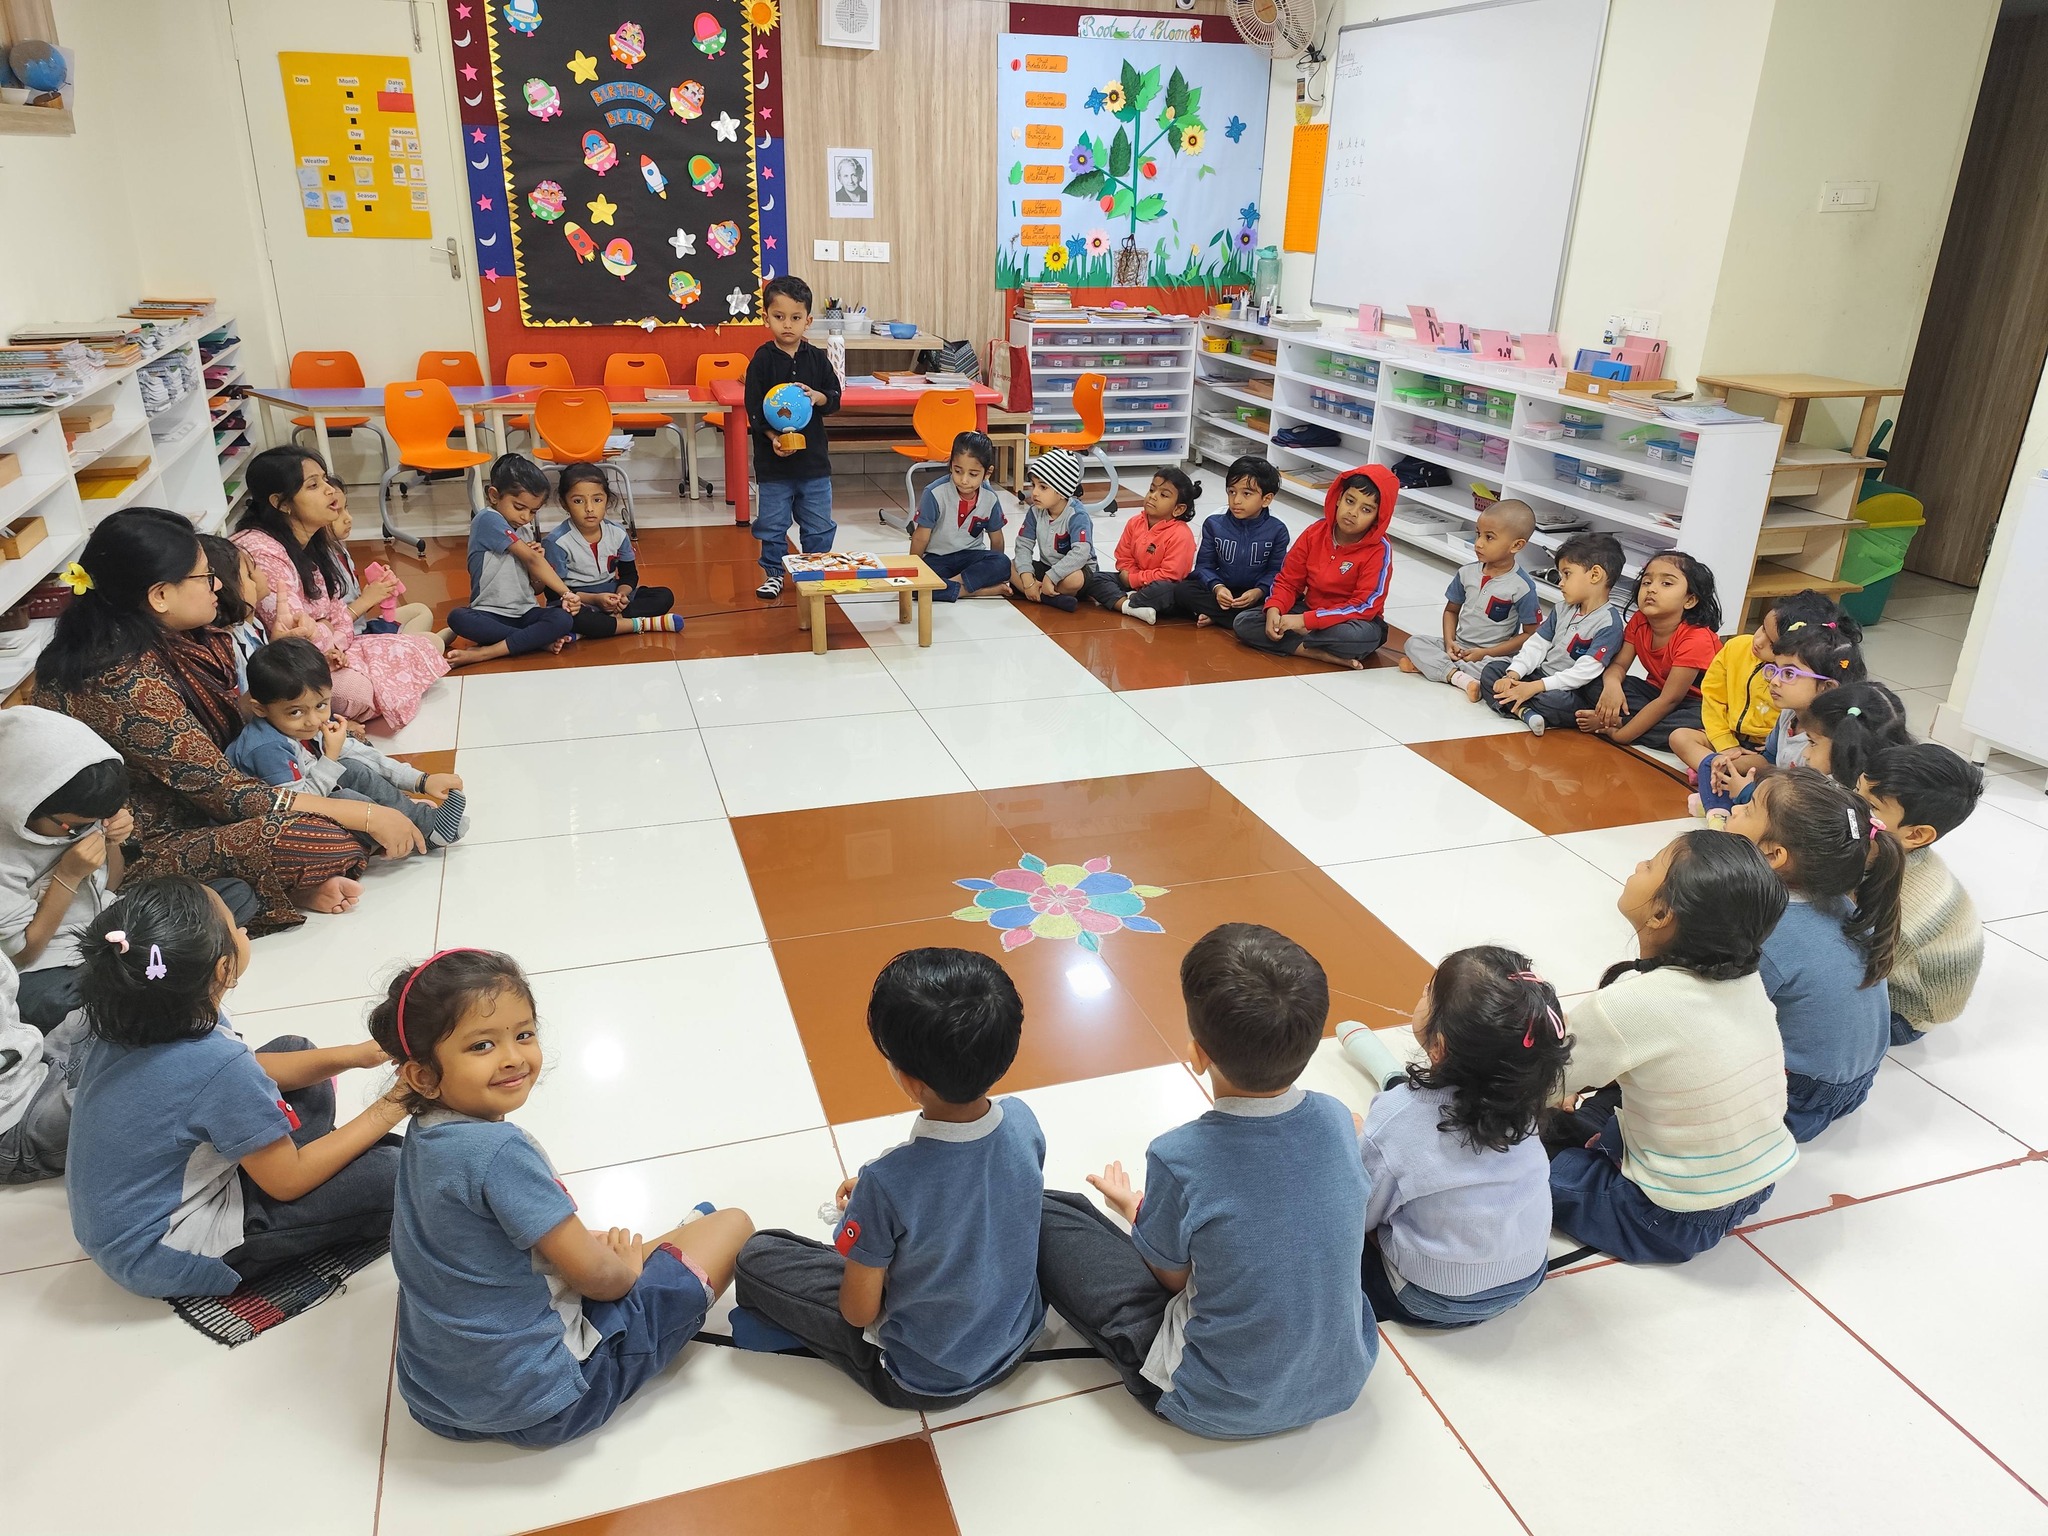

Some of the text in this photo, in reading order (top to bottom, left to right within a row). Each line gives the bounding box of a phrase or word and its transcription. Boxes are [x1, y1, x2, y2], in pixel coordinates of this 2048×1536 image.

[1083, 16, 1123, 38] Root
[1131, 19, 1148, 39] to
[591, 83, 663, 110] BIRTHDAY
[606, 110, 652, 127] BLAST
